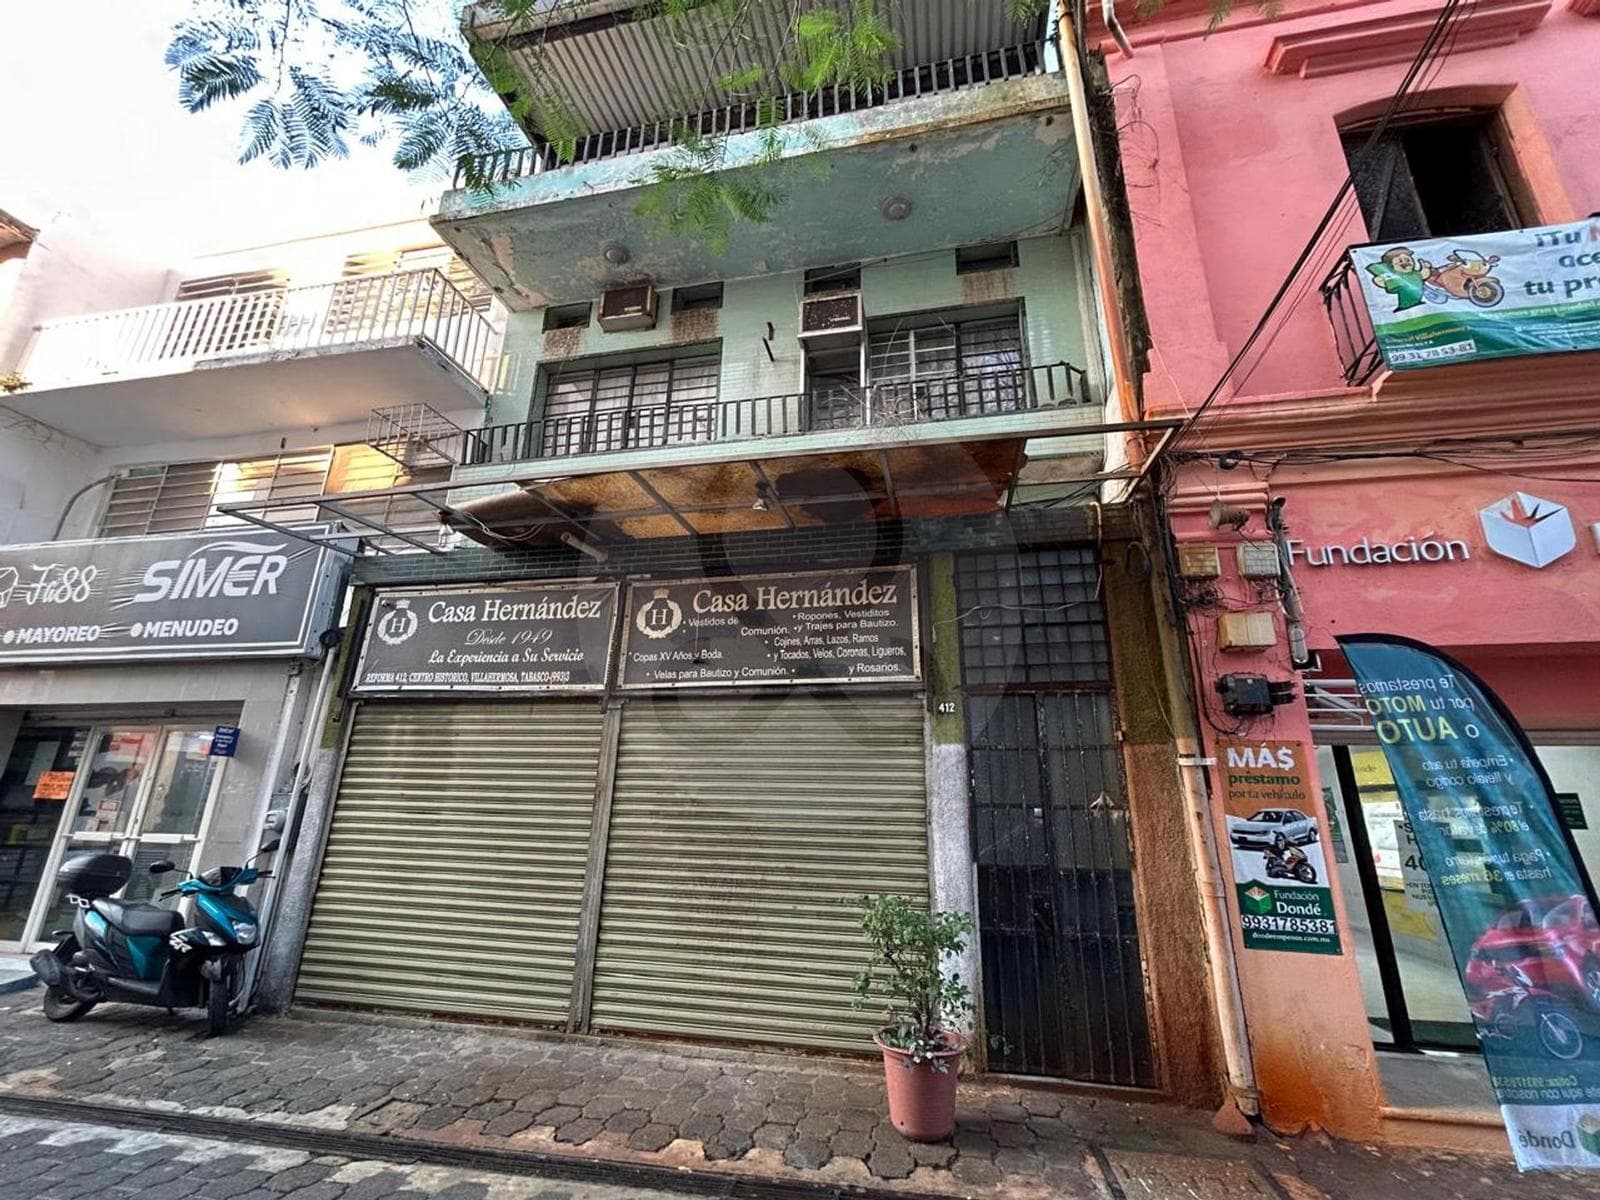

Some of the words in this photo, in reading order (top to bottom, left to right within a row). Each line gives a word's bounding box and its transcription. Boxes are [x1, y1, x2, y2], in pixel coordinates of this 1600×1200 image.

[1523, 280, 1555, 296] tu
[1563, 276, 1600, 298] pr
[1286, 530, 1470, 566] Fundación
[133, 555, 287, 602] SIMER
[693, 590, 750, 613] Casa
[756, 579, 897, 610] Hernández
[428, 601, 476, 623] Casa
[481, 595, 602, 621] Hernández
[844, 608, 890, 618] Vestiditos
[143, 618, 239, 638] MENUDEO
[688, 617, 725, 627] Vestidos
[727, 616, 739, 626] de
[797, 624, 803, 632] y
[806, 621, 834, 632] Trajes
[836, 620, 858, 631] para
[16, 625, 100, 644] MAYOREO
[464, 628, 506, 645] Desde
[511, 629, 553, 645] 1949
[852, 633, 879, 643] Ramos
[428, 650, 444, 663] La
[447, 649, 508, 667] Experiencia
[522, 648, 539, 662] Su
[541, 648, 584, 662] Servicio
[633, 653, 658, 663] Copas
[660, 650, 672, 660] XV
[773, 653, 779, 662] y
[654, 670, 677, 680] Velas
[678, 669, 698, 681] para
[700, 667, 732, 679] Bautizo
[734, 669, 740, 679] y
[848, 664, 855, 675] y
[938, 702, 956, 713] 412
[1228, 773, 1300, 787] préstamo
[1229, 790, 1246, 801] por
[1273, 890, 1320, 901] Fundación
[1276, 901, 1322, 916] Dondé
[1242, 915, 1338, 935] 9931785381
